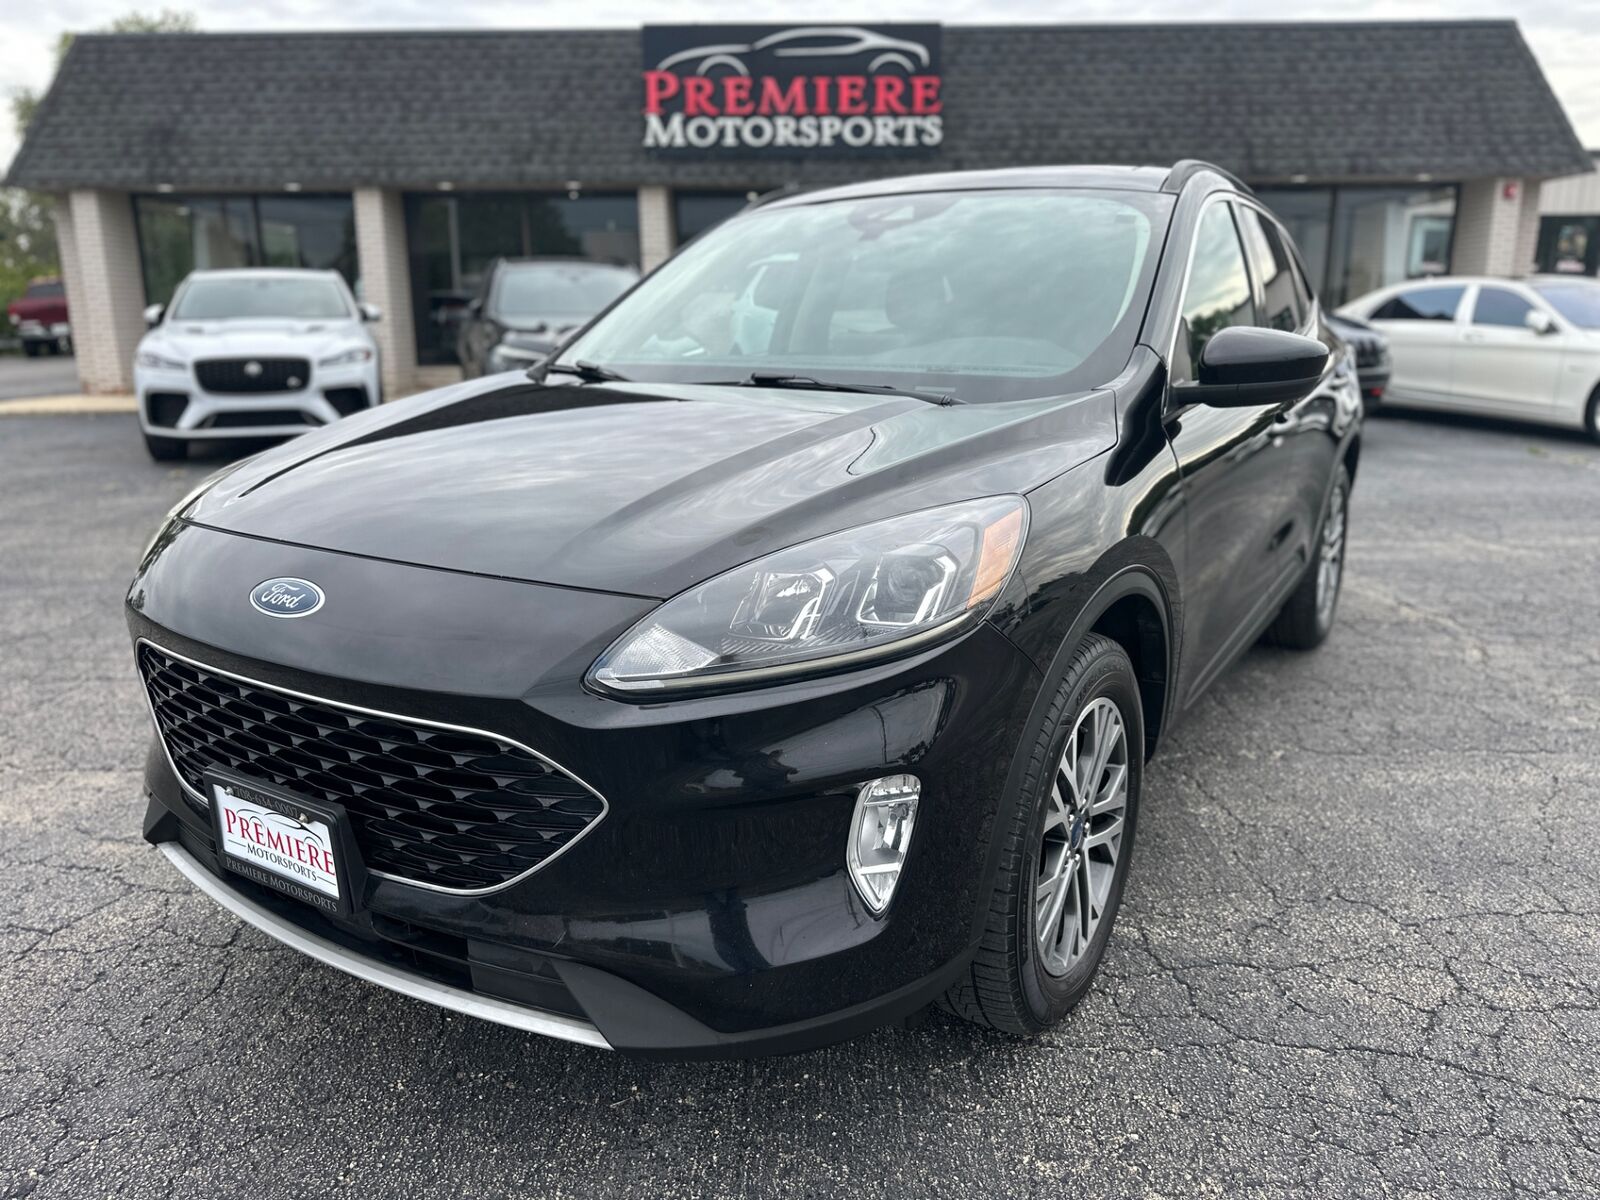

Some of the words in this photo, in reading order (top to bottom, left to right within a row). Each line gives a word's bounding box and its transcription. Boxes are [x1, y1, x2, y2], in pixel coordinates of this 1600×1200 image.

[642, 70, 943, 116] PREMIERE
[642, 113, 943, 147] MOTORSPORTS
[261, 583, 306, 608] Ford
[224, 807, 336, 876] PREMIERE
[247, 843, 317, 882] MOTORSPORTS
[226, 857, 268, 883] PREMIERE
[270, 876, 337, 912] MOTORSPORTS
